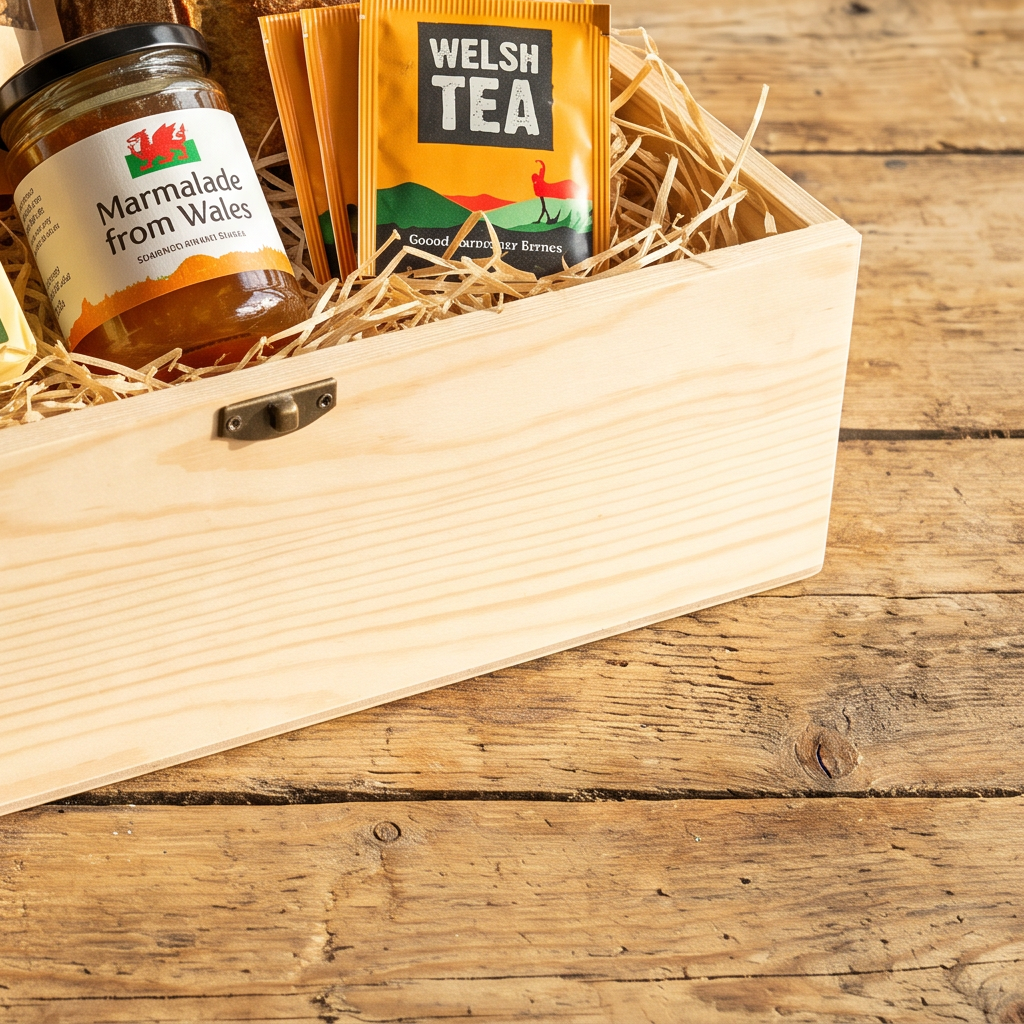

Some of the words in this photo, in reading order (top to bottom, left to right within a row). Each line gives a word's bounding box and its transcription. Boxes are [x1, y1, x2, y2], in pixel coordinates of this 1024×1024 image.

[429, 38, 539, 74] WELSH
[431, 75, 540, 136] TEA
[96, 167, 243, 226] Marmalade
[105, 216, 176, 256] from
[177, 196, 253, 227] Wales
